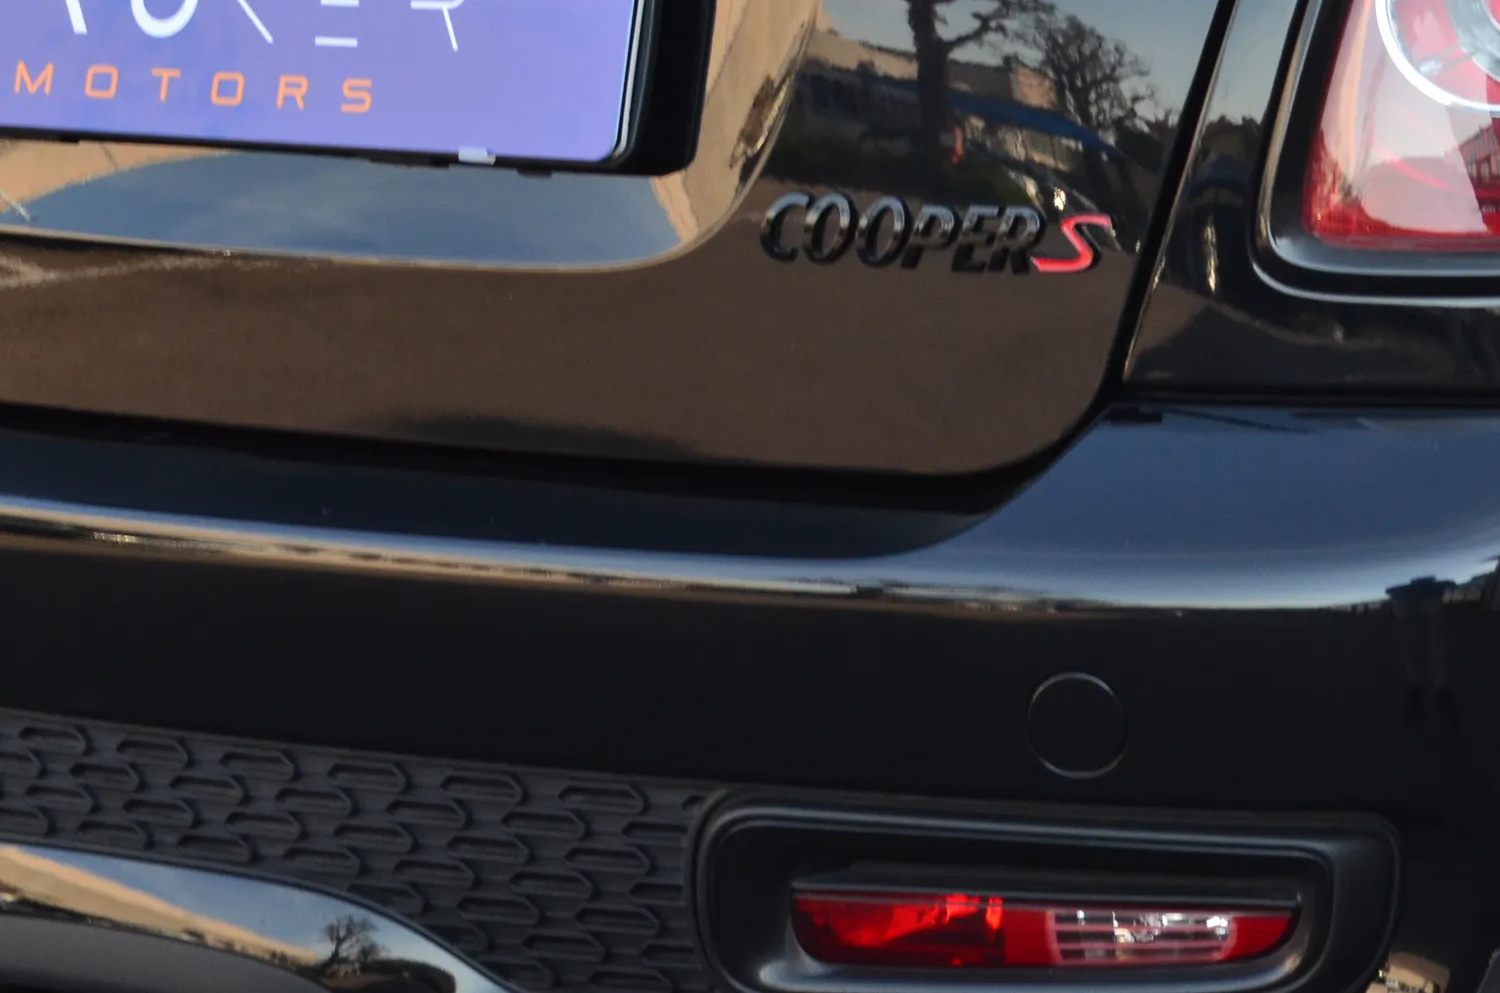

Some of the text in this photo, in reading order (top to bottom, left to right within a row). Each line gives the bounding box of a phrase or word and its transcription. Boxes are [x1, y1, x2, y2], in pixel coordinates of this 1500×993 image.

[13, 59, 374, 114] MOTORS
[760, 190, 1117, 275] COOPER S
